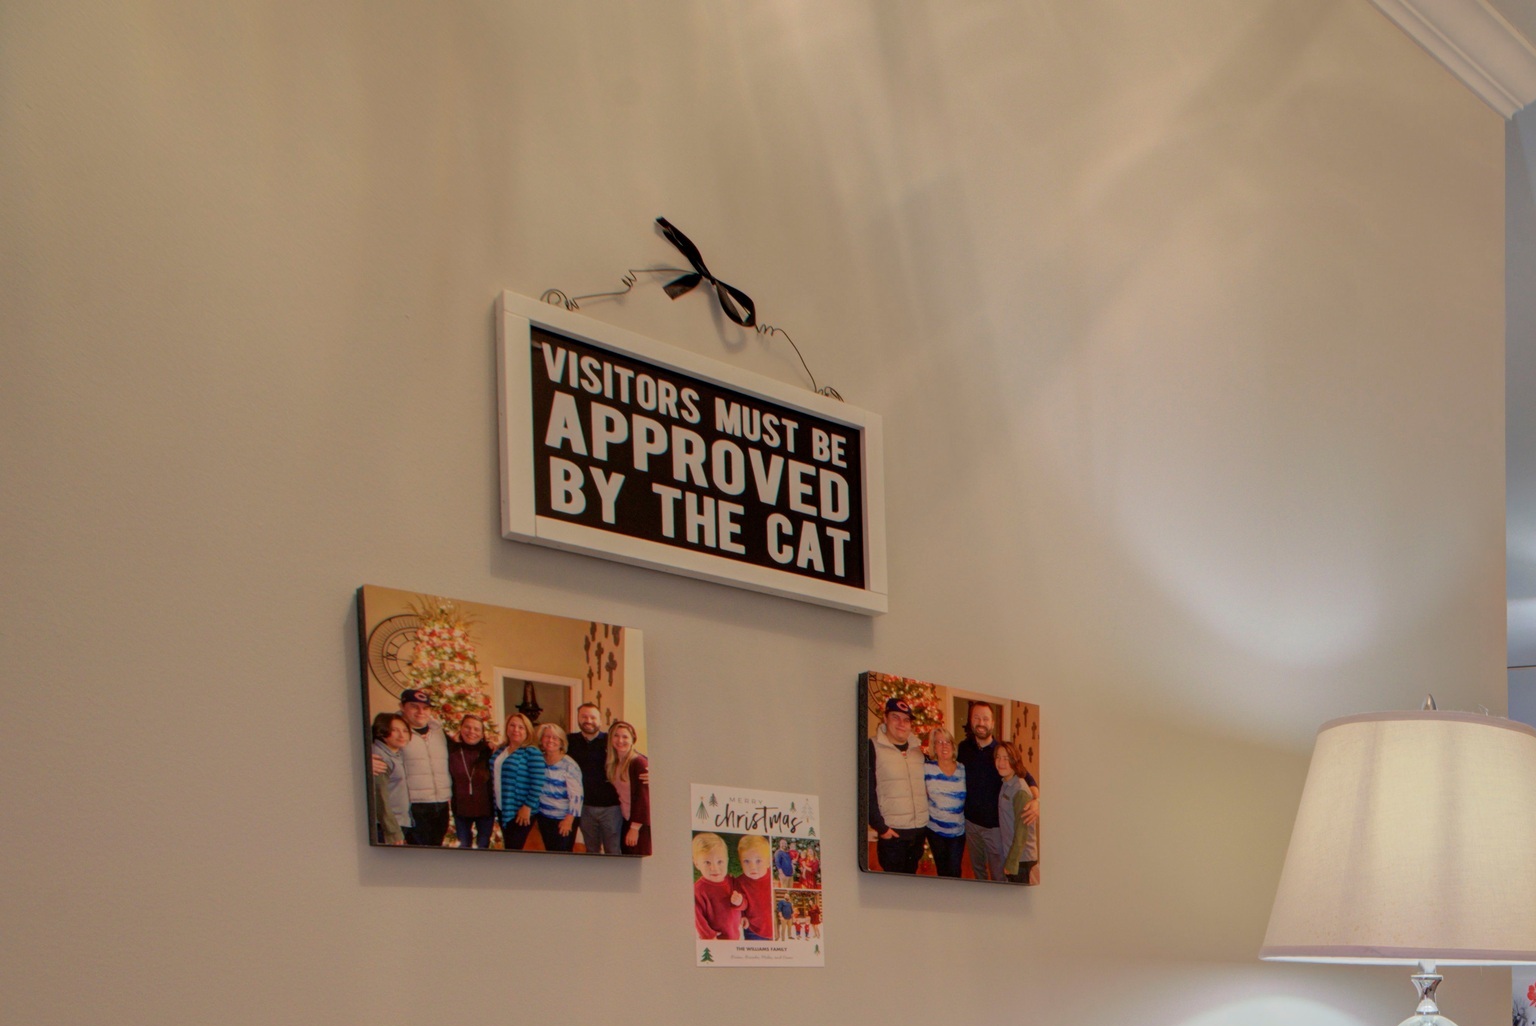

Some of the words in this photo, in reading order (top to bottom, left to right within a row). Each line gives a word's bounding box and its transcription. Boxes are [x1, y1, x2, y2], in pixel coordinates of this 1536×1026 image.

[541, 341, 701, 424] VISITORS
[715, 396, 799, 453] MUST
[812, 427, 847, 469] BE
[544, 390, 851, 523] APPROVED
[549, 455, 626, 525] BY
[652, 481, 746, 555] THE
[766, 512, 851, 578] CAT
[729, 796, 763, 805] MERRY
